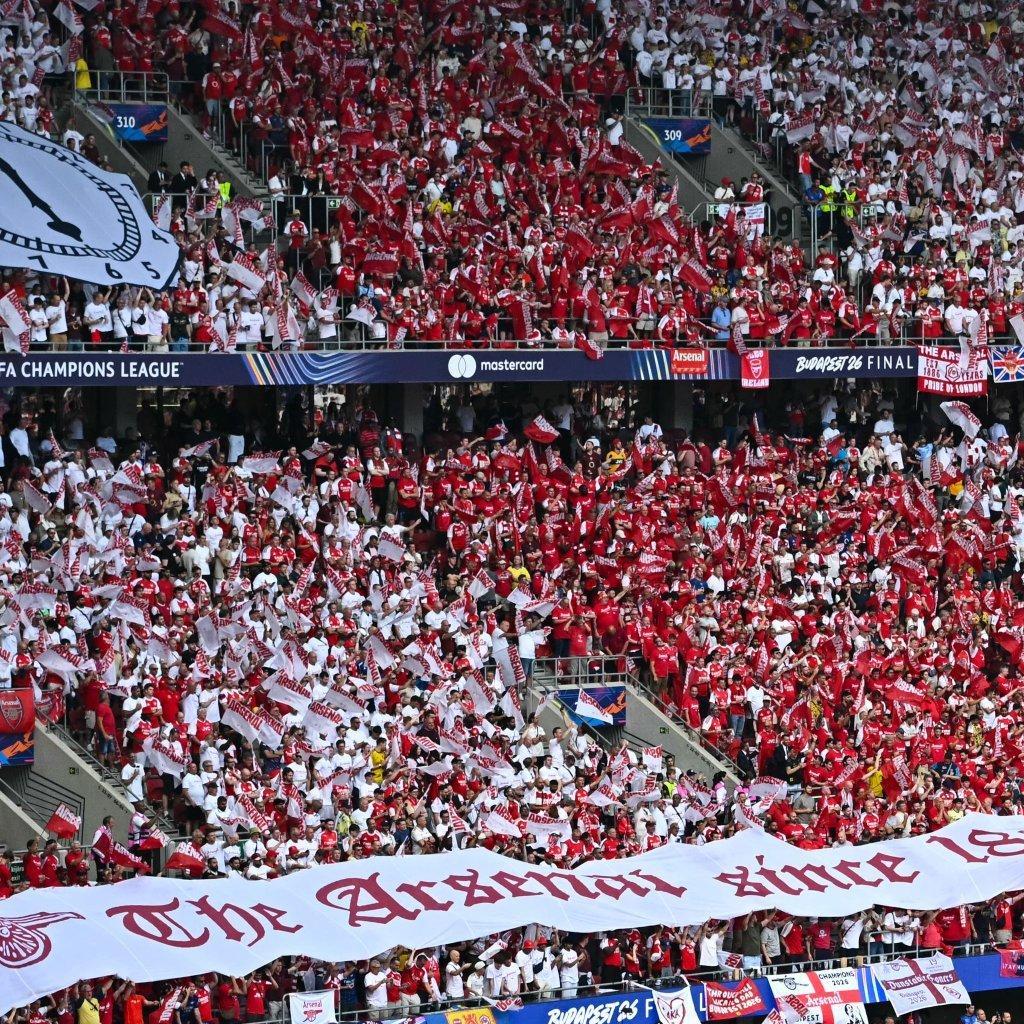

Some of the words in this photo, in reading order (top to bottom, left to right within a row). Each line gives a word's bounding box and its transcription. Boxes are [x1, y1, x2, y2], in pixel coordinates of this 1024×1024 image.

[116, 116, 136, 128] 310
[664, 130, 682, 141] 309
[28, 255, 48, 270] 7
[105, 262, 123, 281] 6
[141, 261, 161, 280] 5
[673, 349, 705, 362] Arsenal
[920, 345, 939, 357] THE
[940, 347, 988, 362] ARSAL
[21, 362, 115, 378] CHAMPIONS
[120, 362, 180, 378] LEAGUE
[480, 358, 544, 371] mastercard
[796, 356, 847, 373] BUDAPEST
[846, 354, 863, 370] 26
[867, 355, 914, 370] FINAL
[105, 895, 304, 948] The
[315, 869, 688, 928] Arsenal
[714, 852, 921, 898] since
[817, 970, 854, 981] CHAMPIONS
[831, 978, 850, 986] 2026
[303, 1000, 323, 1009] Arsenal
